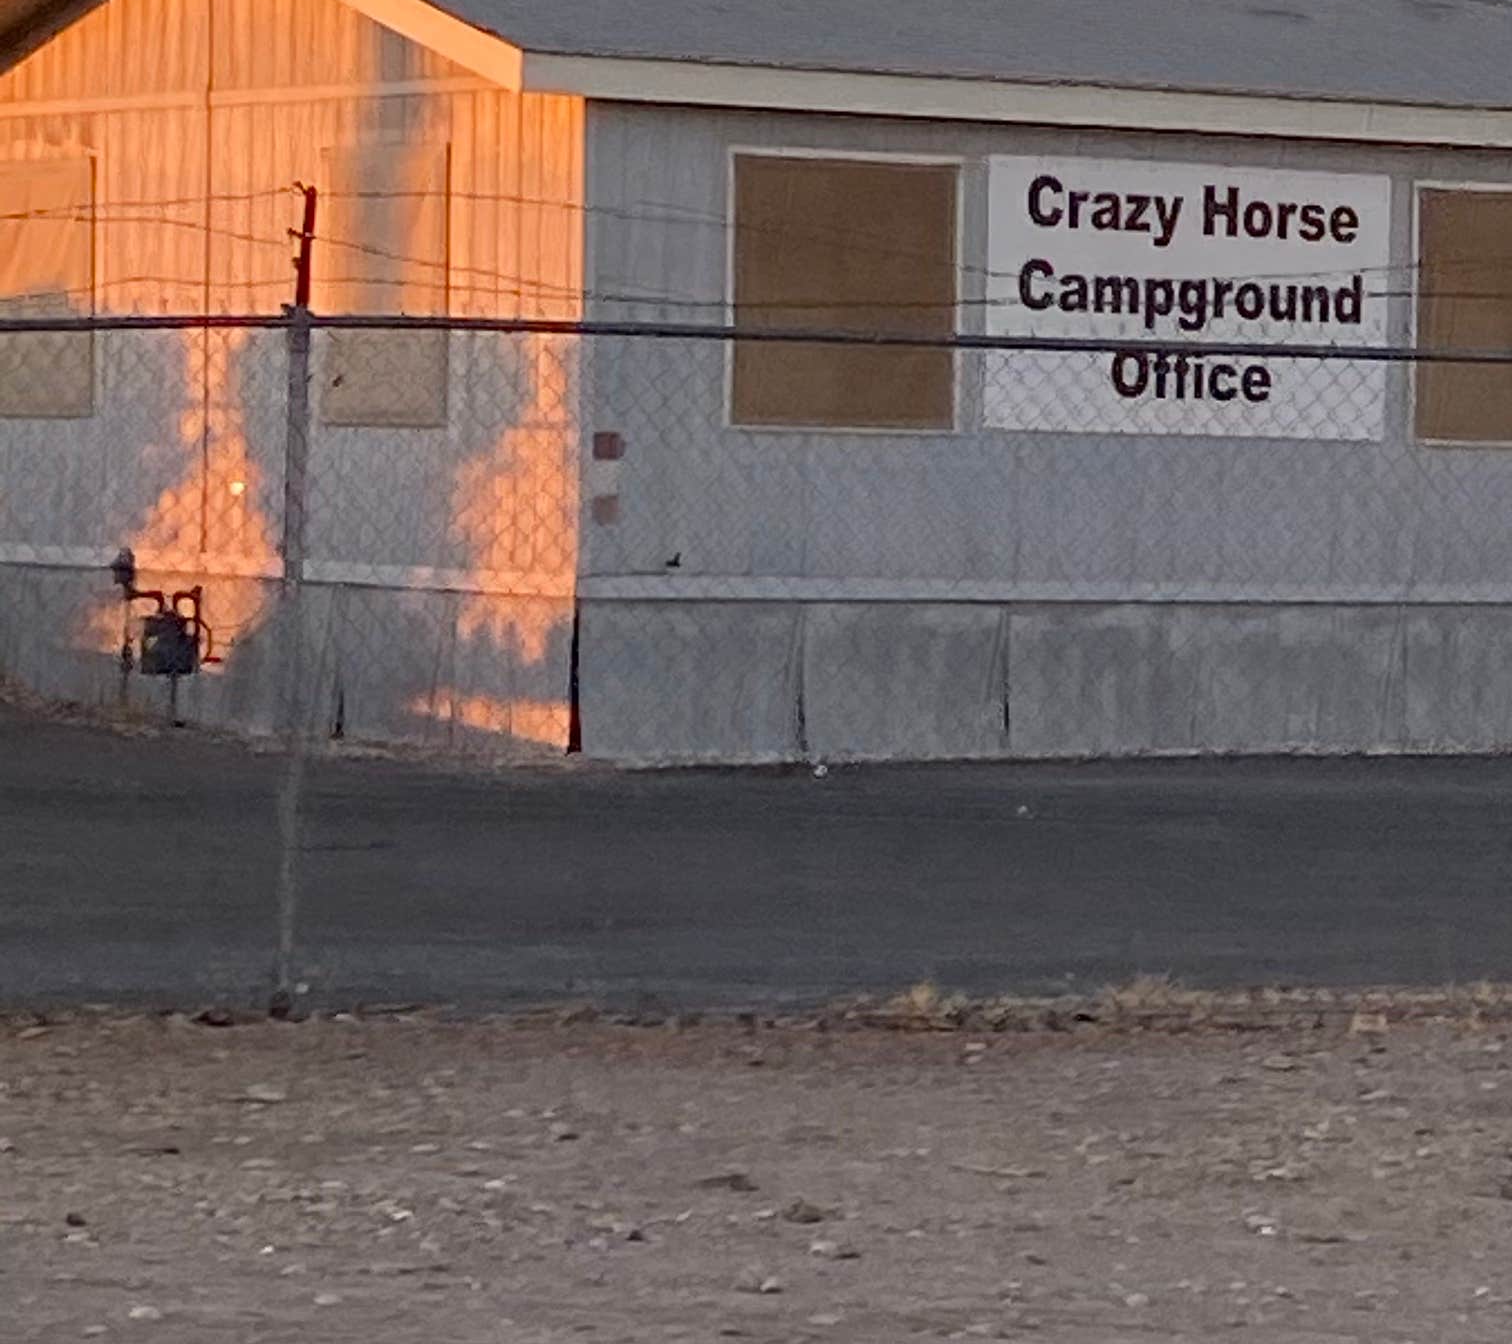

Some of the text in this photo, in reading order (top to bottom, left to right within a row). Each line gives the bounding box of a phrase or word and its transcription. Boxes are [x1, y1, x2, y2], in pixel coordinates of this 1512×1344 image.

[1027, 174, 1360, 246] Crazy Horse
[1018, 258, 1363, 331] Campground
[1111, 350, 1272, 402] Office
